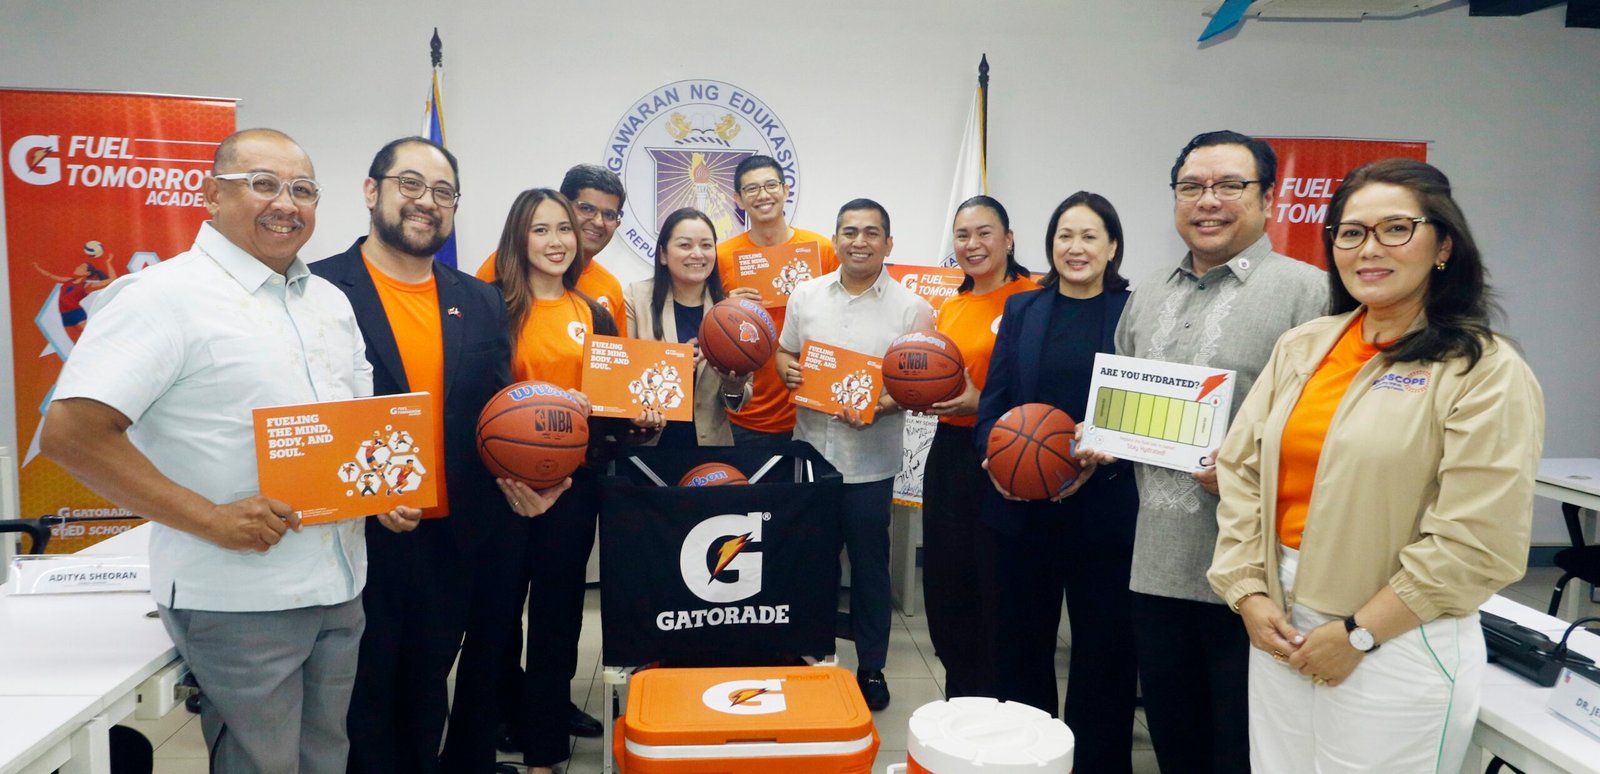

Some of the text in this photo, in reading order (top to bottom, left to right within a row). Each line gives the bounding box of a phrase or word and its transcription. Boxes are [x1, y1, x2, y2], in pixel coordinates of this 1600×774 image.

[607, 87, 680, 177] GAWARAN
[690, 84, 719, 100] NG
[68, 135, 135, 160] FUEL
[67, 164, 211, 191] TOMORRO
[1279, 177, 1334, 198] FUEL
[145, 191, 208, 207] ACADE
[920, 274, 943, 284] FUEL
[592, 341, 623, 350] FUELING
[808, 345, 834, 356] FUELING
[614, 357, 630, 365] AND
[823, 361, 837, 369] AND
[907, 352, 928, 370] NBA
[1100, 367, 1200, 389] ARE YOU HYDRATED?
[266, 414, 319, 427] FUELING
[548, 409, 573, 433] NBA
[267, 424, 331, 438] THE MIND,
[269, 434, 334, 448] BODY, AND
[269, 448, 305, 460] SOUL.
[89, 525, 132, 535] SCHOO
[49, 572, 137, 582] ADITYA SHEORAN
[656, 604, 790, 631] GATORADE
